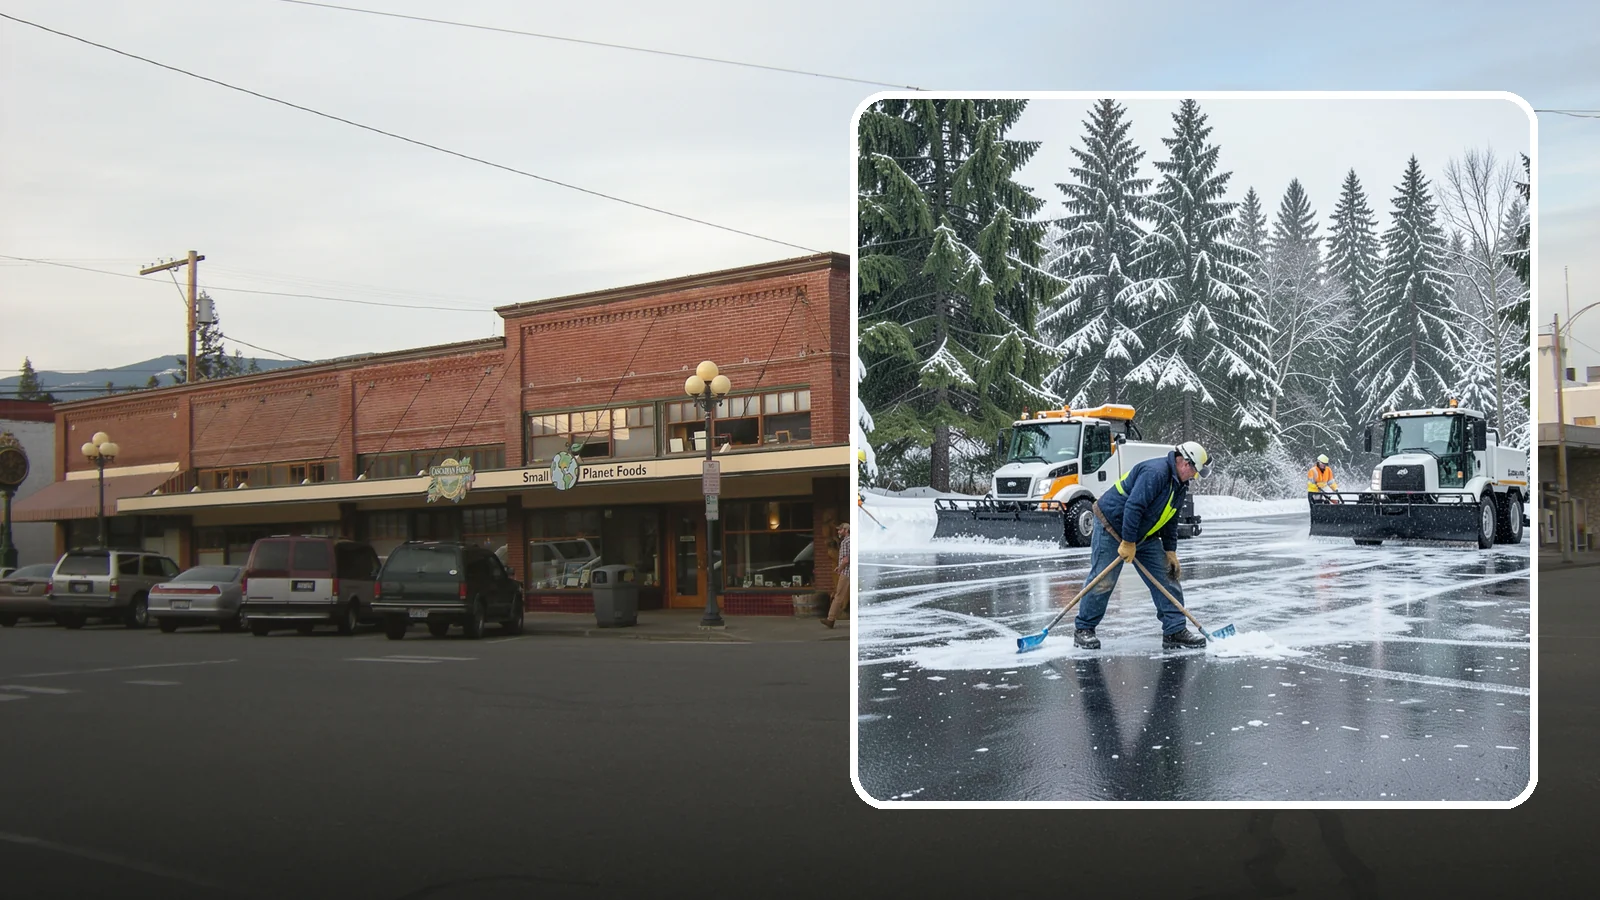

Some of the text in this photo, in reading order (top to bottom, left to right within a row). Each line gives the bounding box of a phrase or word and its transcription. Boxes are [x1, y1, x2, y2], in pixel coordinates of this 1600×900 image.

[523, 464, 647, 483] Small Planet Foods
